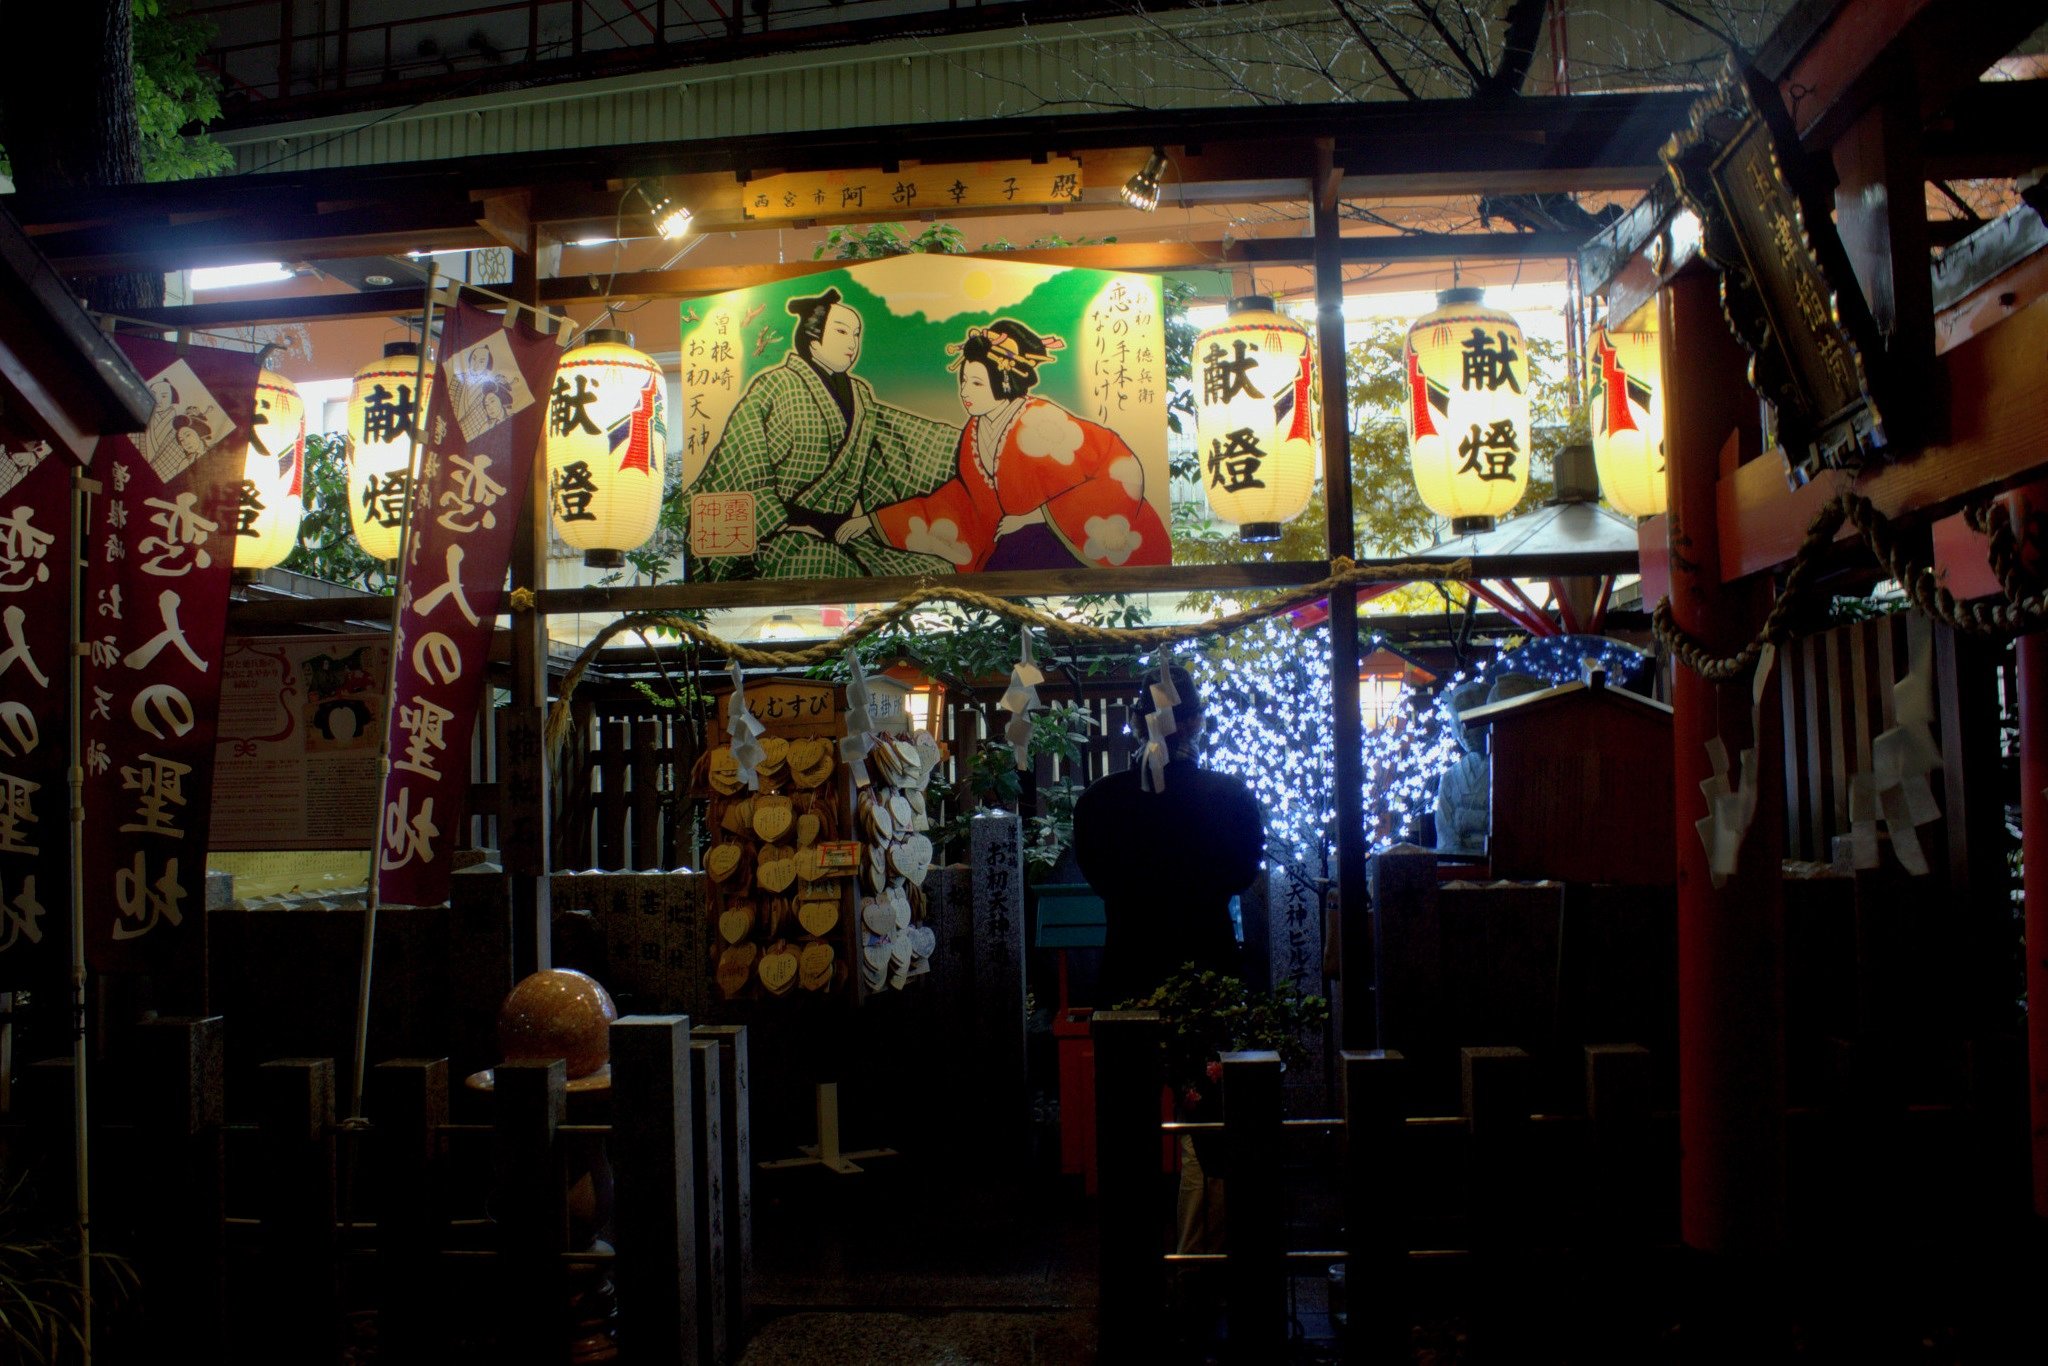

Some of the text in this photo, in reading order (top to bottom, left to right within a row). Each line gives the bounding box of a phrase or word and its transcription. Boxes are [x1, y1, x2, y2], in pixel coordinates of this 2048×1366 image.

[686, 339, 712, 456] お初天神
[1091, 310, 1110, 425] なりにけり
[1108, 282, 1133, 412] 恋の手本と
[1458, 328, 1524, 483] 献燈
[549, 374, 602, 522] 献燈
[1203, 339, 1269, 494] 献燈
[749, 692, 829, 721] んむすび
